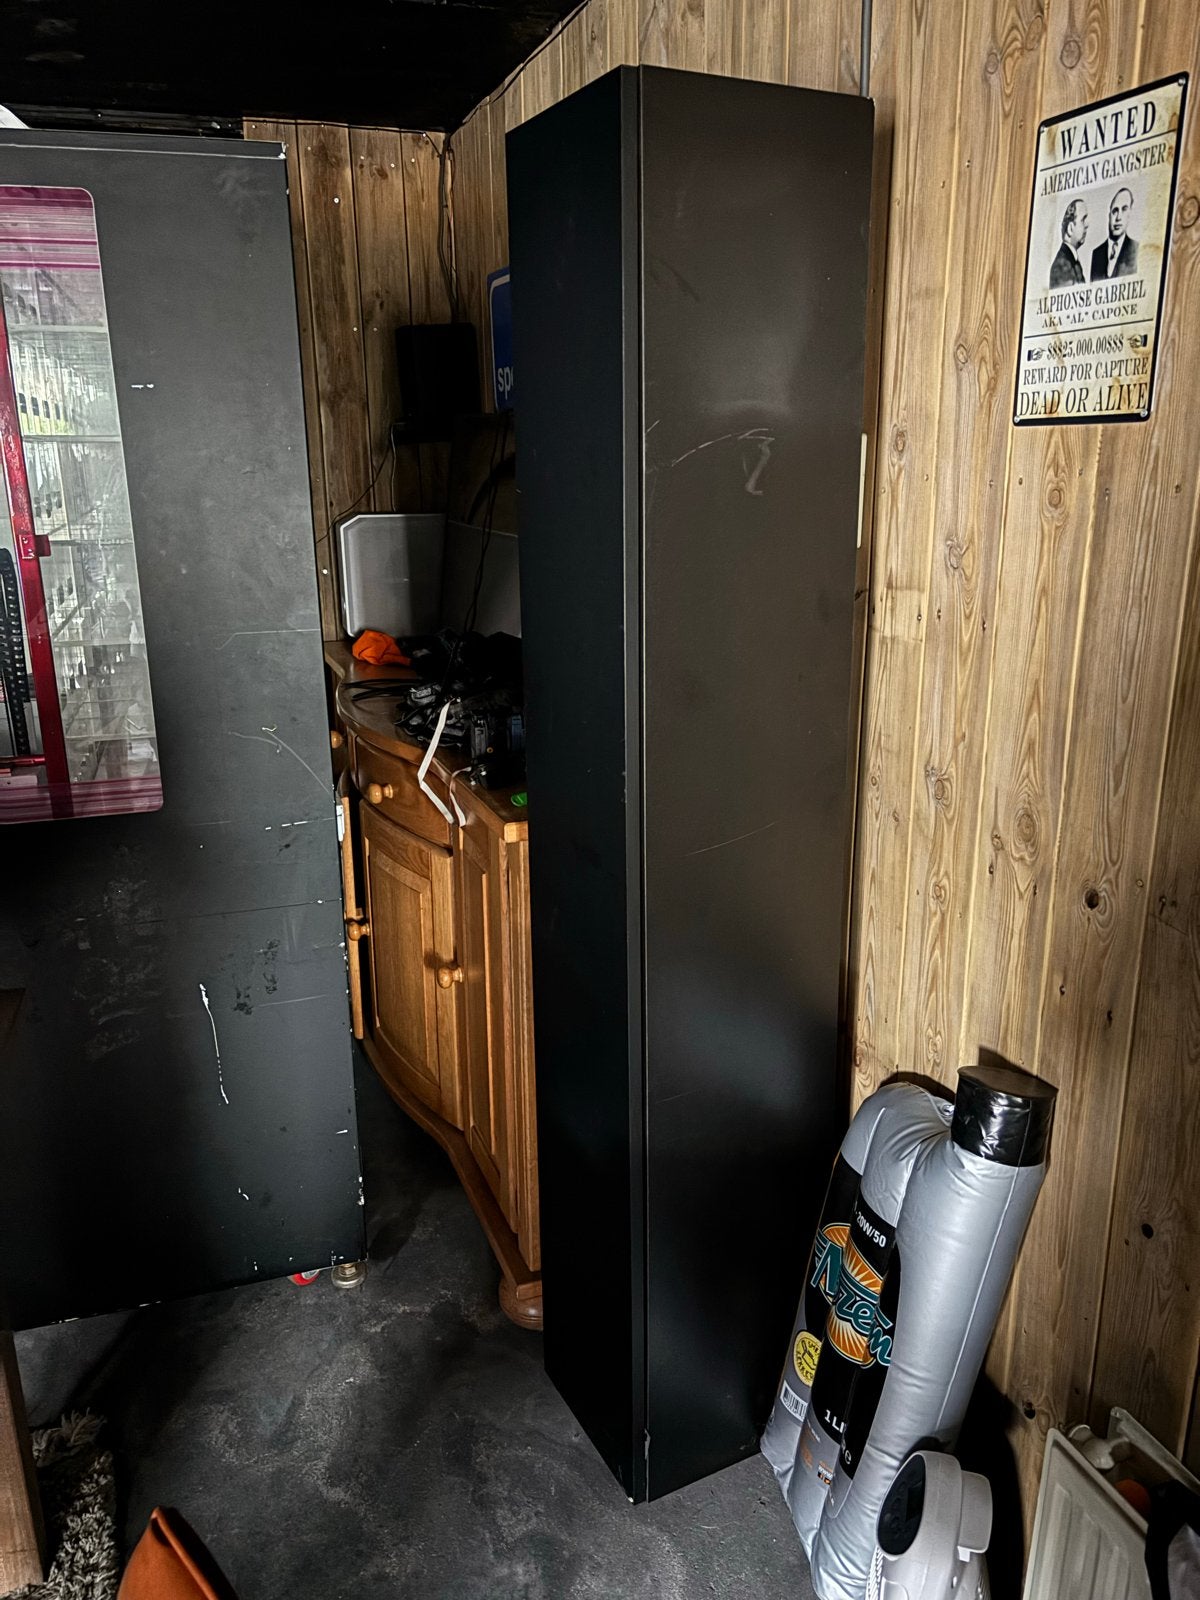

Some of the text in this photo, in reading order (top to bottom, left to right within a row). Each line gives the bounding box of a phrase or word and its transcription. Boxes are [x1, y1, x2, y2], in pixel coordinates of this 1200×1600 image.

[1060, 101, 1156, 160] WANTED
[1041, 143, 1166, 196] AMERICAN GANGSTER
[1036, 279, 1146, 315] ALPHONSE GABRIEL
[1042, 315, 1063, 329] AKA
[1092, 304, 1138, 321] CAPONE
[1023, 356, 1149, 385] REWARD FOR CAPTURE
[1019, 382, 1148, 416] DEAD OR ALIVE
